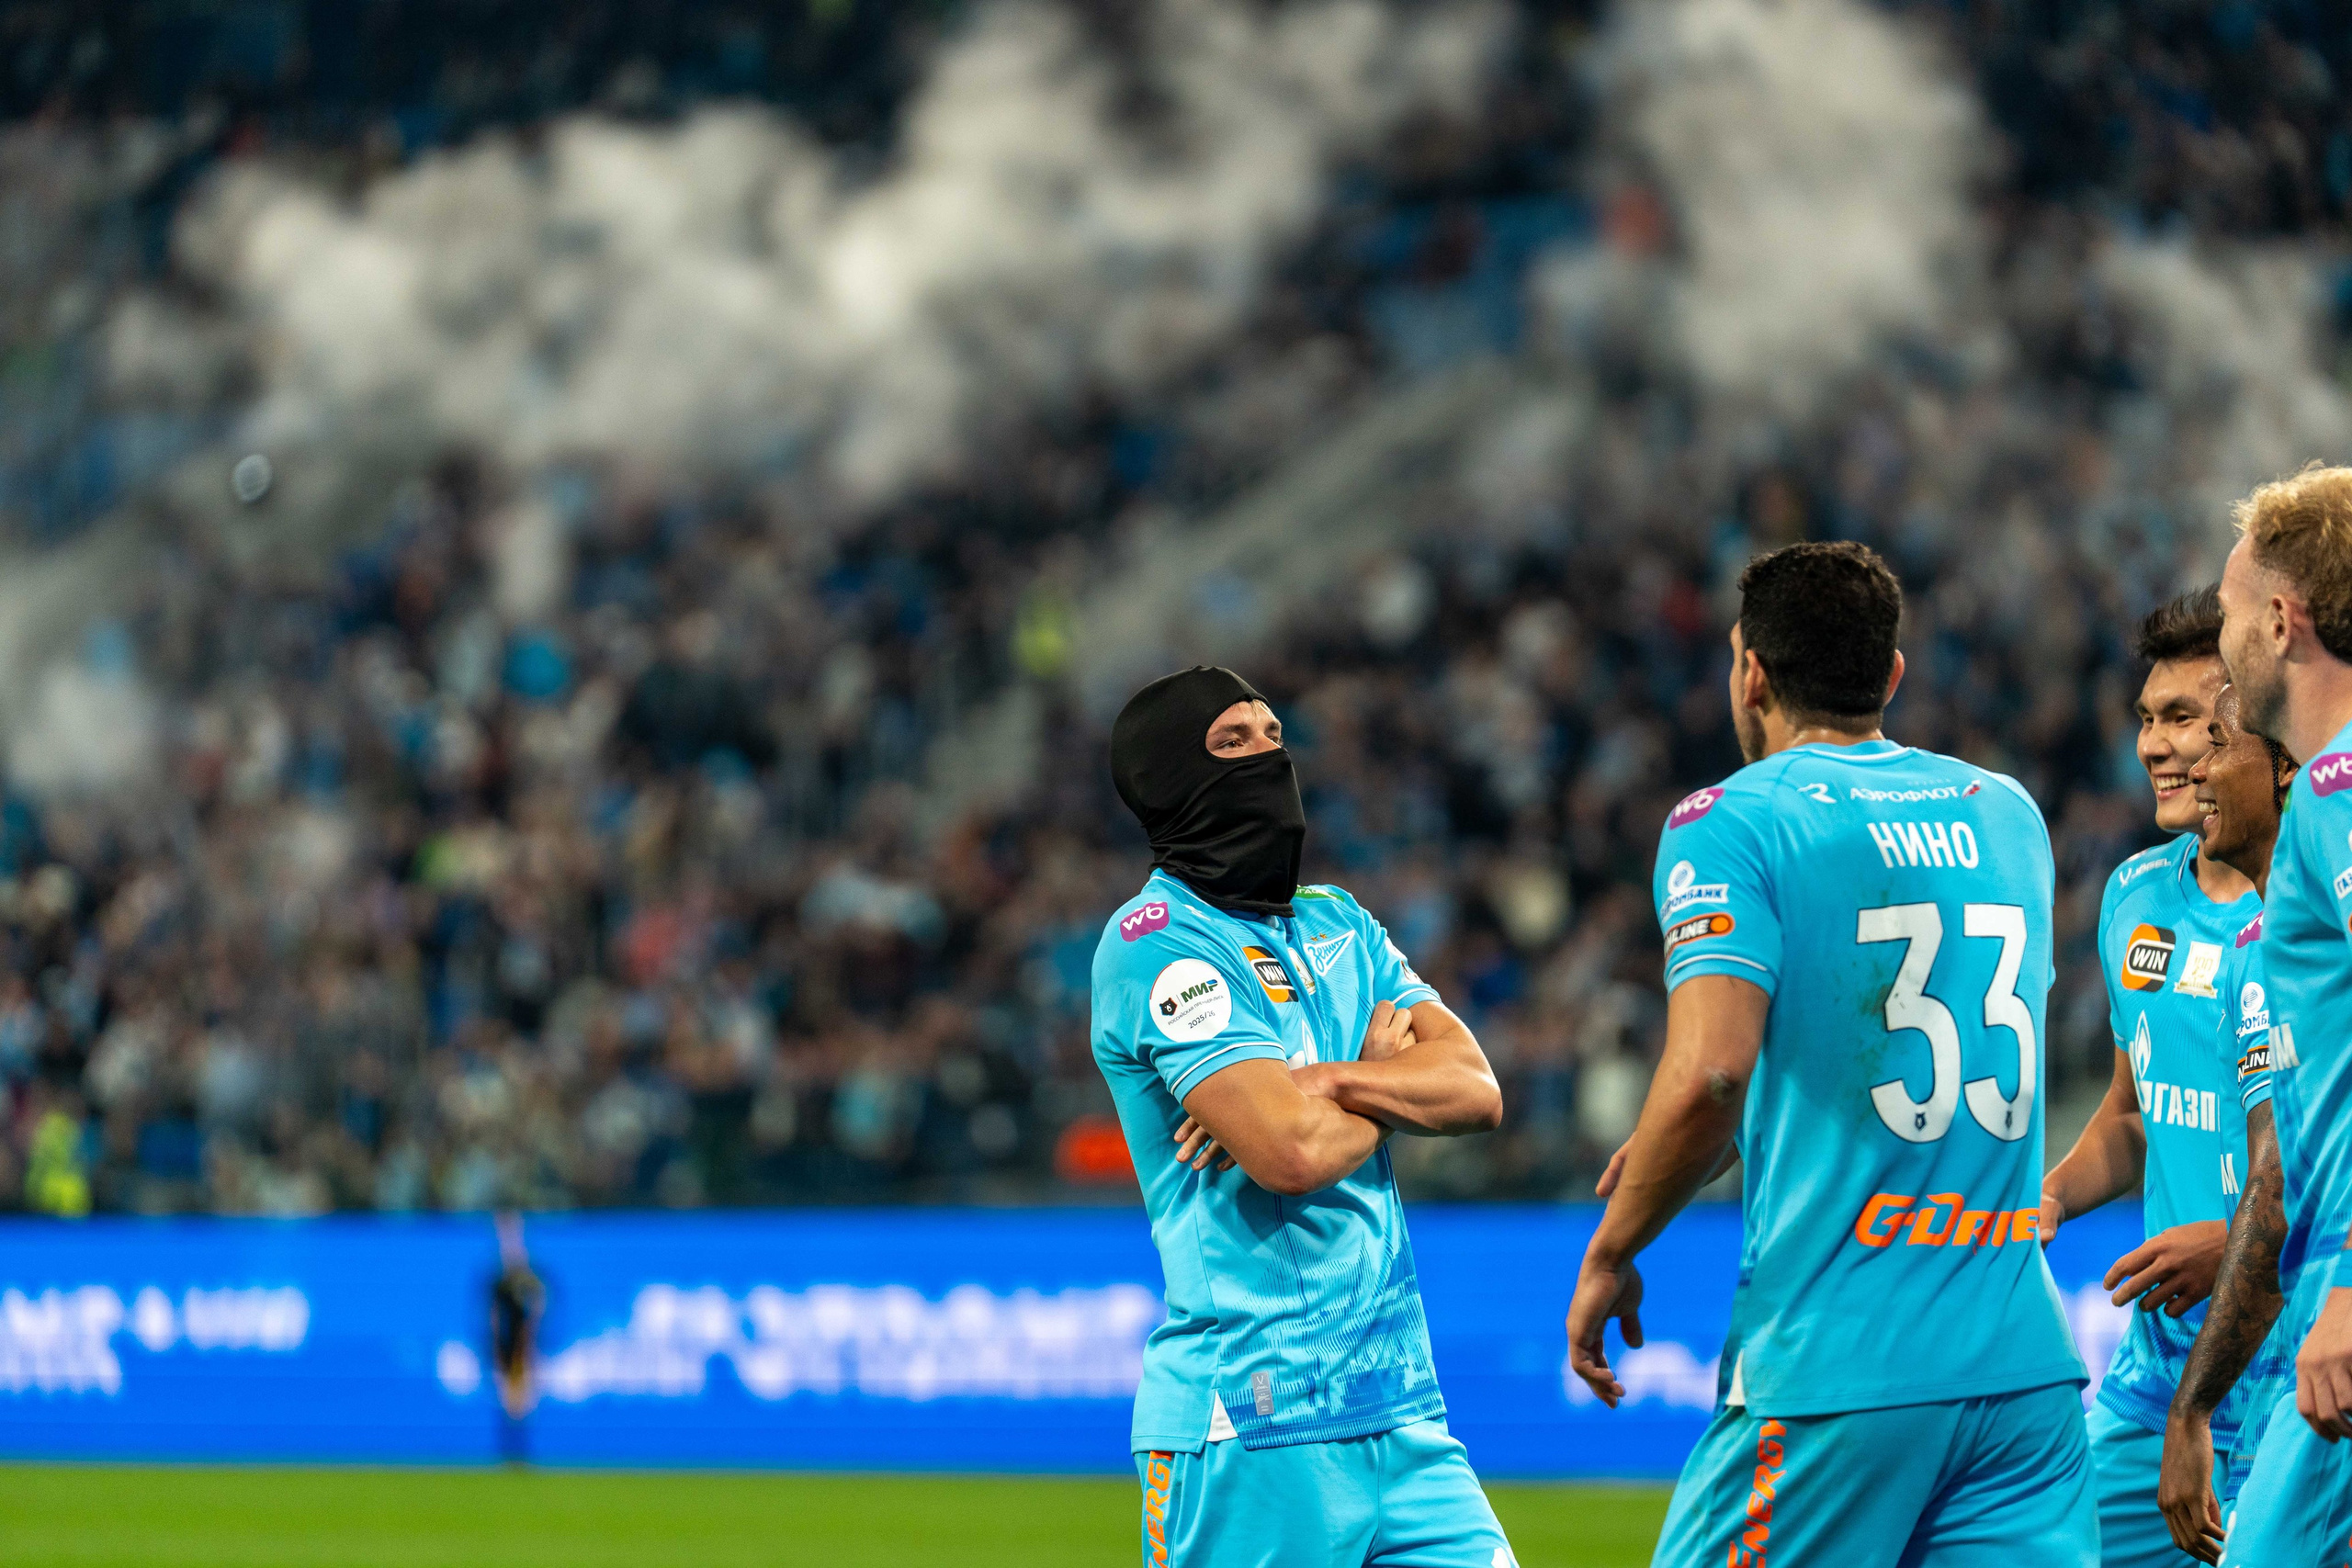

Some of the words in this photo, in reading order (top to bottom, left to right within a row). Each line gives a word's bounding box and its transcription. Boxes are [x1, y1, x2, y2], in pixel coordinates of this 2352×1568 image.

[1850, 786, 1959, 802] АЭРОФЛОТ
[1867, 821, 1979, 869] НИНО
[1122, 907, 1164, 931] wb
[2132, 947, 2168, 972] WIN
[1258, 965, 1287, 982] WIN
[1181, 979, 1218, 1003] МИР
[1856, 902, 2036, 1143] 33
